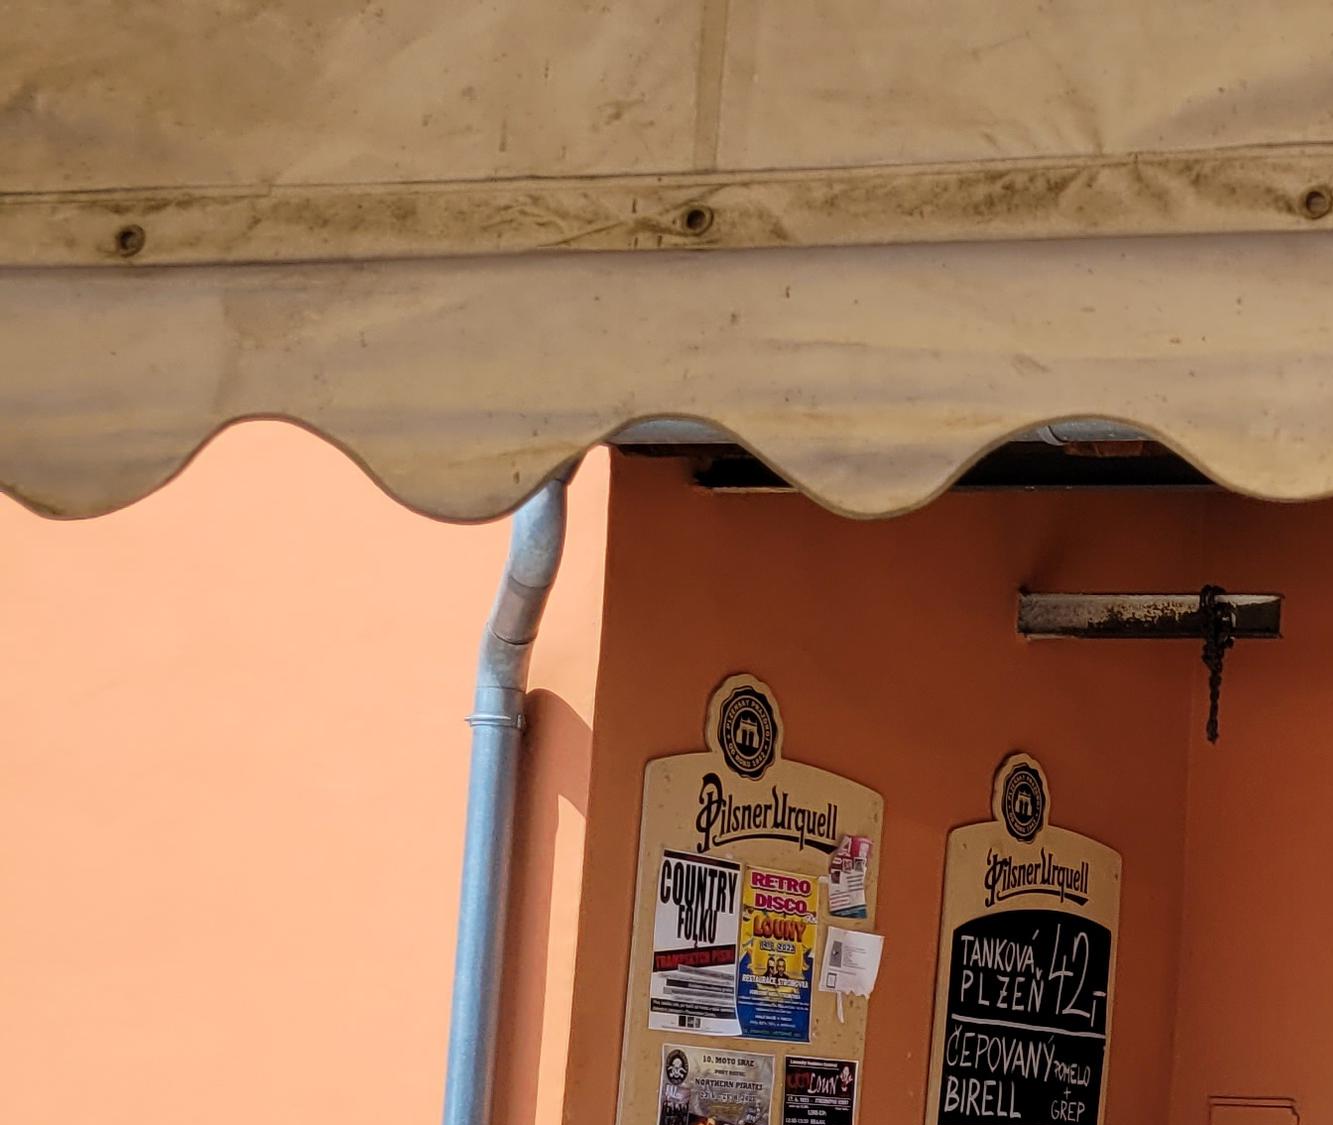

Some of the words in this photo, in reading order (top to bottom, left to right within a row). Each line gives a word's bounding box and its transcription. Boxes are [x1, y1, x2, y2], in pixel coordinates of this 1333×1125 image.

[696, 773, 772, 853] Pilsner
[771, 785, 838, 851] Urquell
[660, 859, 738, 914] COUNTRY
[751, 871, 811, 895] RETRO
[984, 848, 1041, 908] Pilsner
[1040, 848, 1090, 903] Urquell
[677, 904, 718, 944] FOLKU
[755, 893, 808, 913] DISCO
[753, 914, 806, 942] LOUNY
[961, 929, 1039, 973] TANKOVÁ
[961, 969, 1045, 1013] PLZEŇ
[715, 1056, 736, 1065] MOTO
[946, 1024, 1056, 1082] ČEPOVANÝ
[1053, 1060, 1091, 1087] POMELO
[695, 1078, 734, 1088] NORTHERN
[735, 1082, 763, 1091] PIRATES
[944, 1075, 1022, 1119] BIRELL
[1051, 1100, 1086, 1122] GREP
